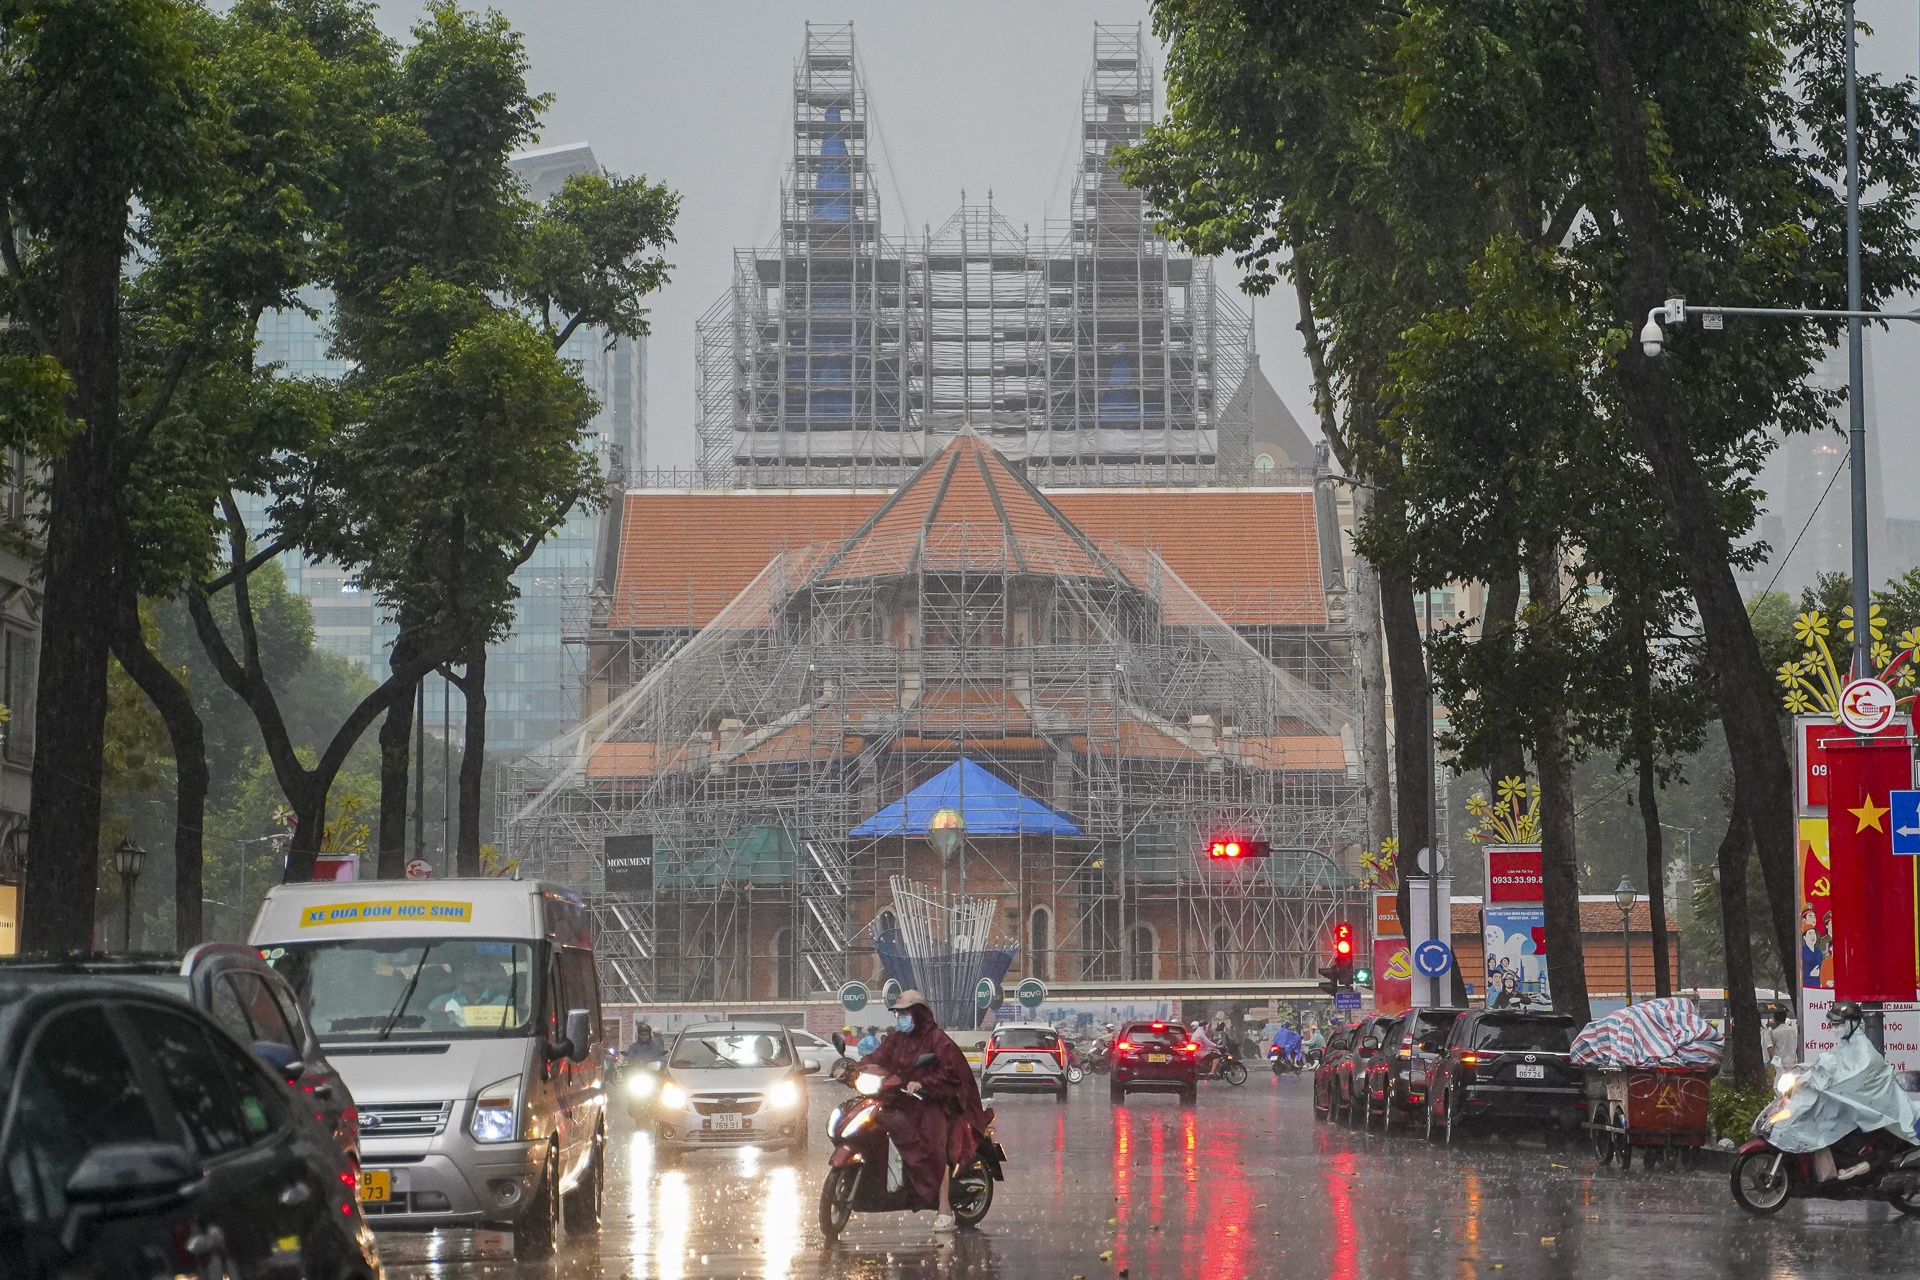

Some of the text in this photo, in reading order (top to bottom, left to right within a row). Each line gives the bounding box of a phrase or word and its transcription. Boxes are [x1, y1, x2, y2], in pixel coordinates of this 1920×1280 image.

[607, 856, 651, 867] MONUMENT
[309, 911, 325, 921] XE
[398, 905, 426, 918] HỌC
[430, 906, 464, 916] SINH
[1809, 1001, 1827, 1009] PHÁT
[1821, 1023, 1832, 1031] ĐẠ
[1889, 1022, 1902, 1032] TỘC
[1806, 1039, 1834, 1052] KẾT HỢP
[1890, 1042, 1904, 1050] THỜI
[1906, 1043, 1918, 1052] ĐẠI
